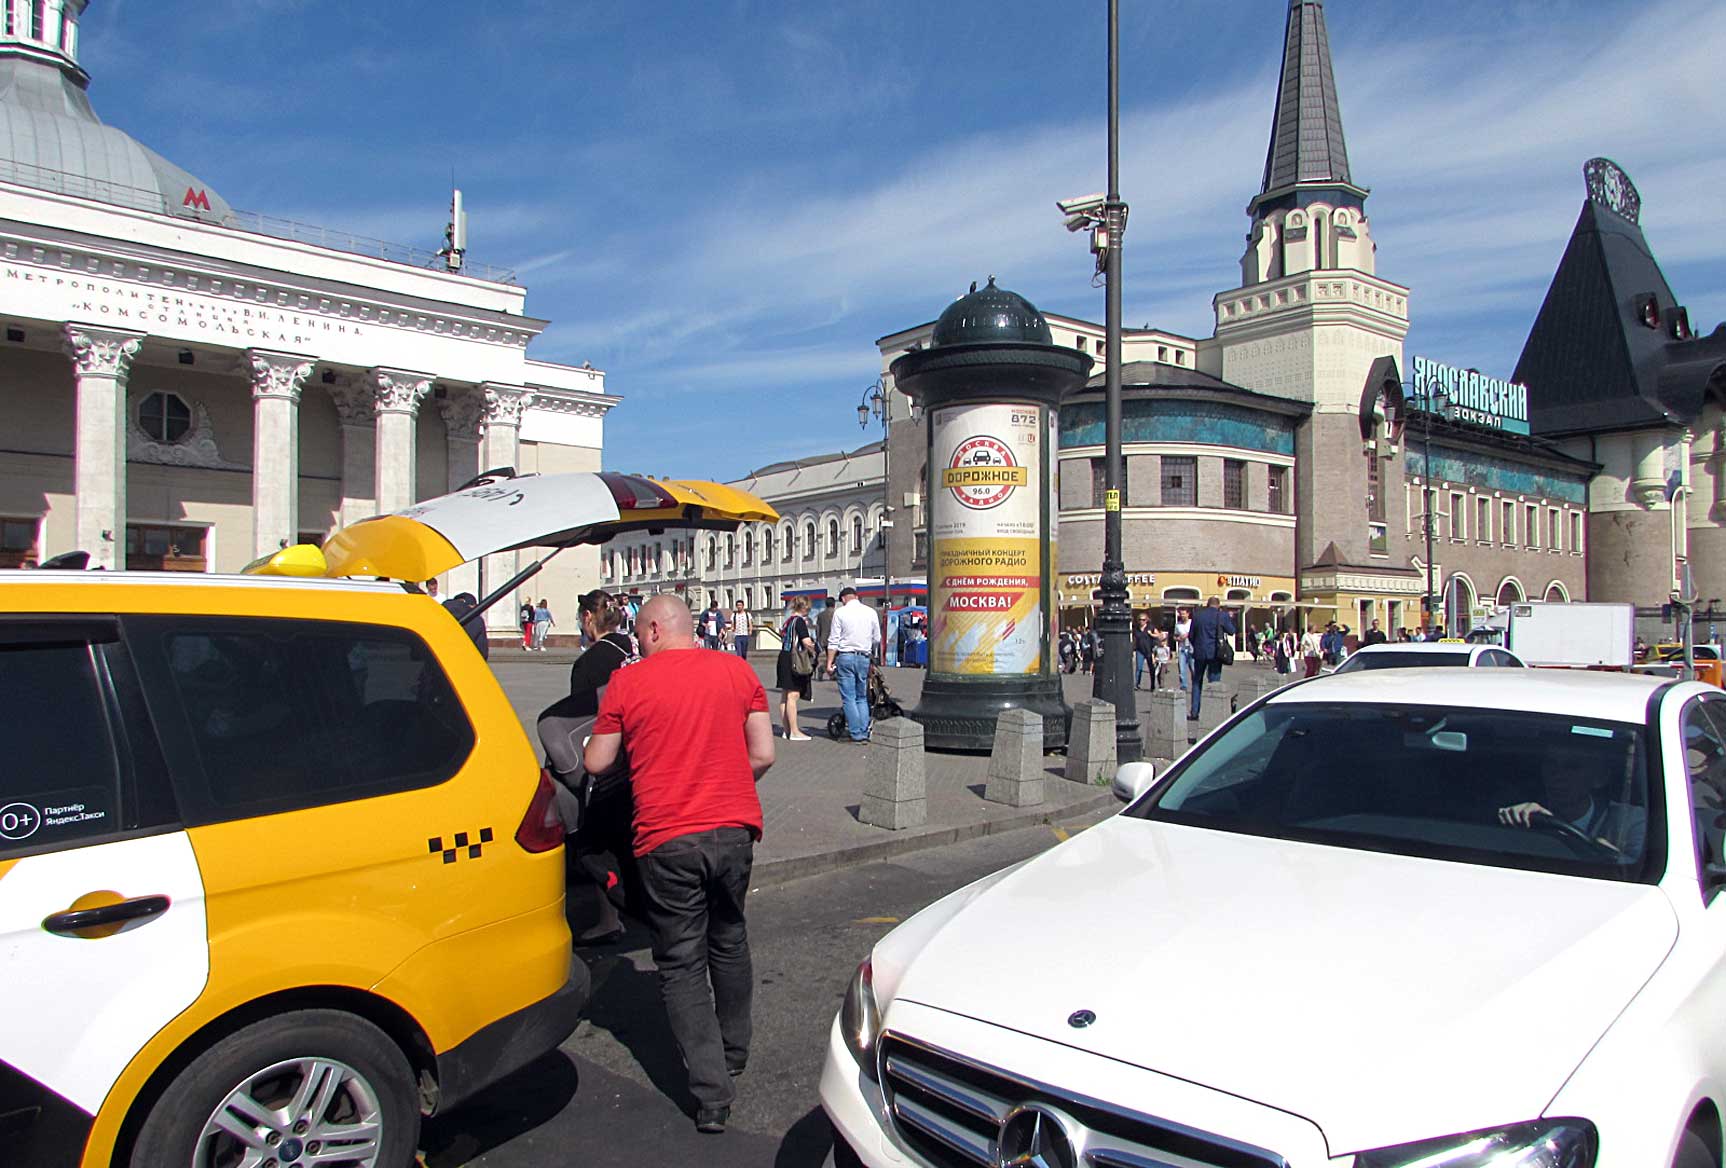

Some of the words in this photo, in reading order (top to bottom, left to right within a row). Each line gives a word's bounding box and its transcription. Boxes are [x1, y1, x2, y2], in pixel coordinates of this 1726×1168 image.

[183, 187, 211, 210] М
[7, 269, 183, 306] МЕТРОПОЛИТЕН
[1413, 356, 1528, 421] ЯРОСЛАВСКИЙ
[958, 440, 1007, 457] МОСКВА
[947, 471, 1019, 483] ДОРОЖНОЕ
[972, 487, 991, 495] 96.0
[961, 492, 1004, 506] РАДИО
[941, 558, 993, 567] ДОРОЖНОГО
[995, 558, 1027, 567] РАДИО
[952, 577, 975, 586] ДНЁМ
[976, 578, 1029, 587] РОЖДЕНИЯ,
[949, 596, 1011, 608] МОСКВА!
[44, 803, 85, 816] Партнёр
[45, 811, 105, 826] Яндекс.Такси
